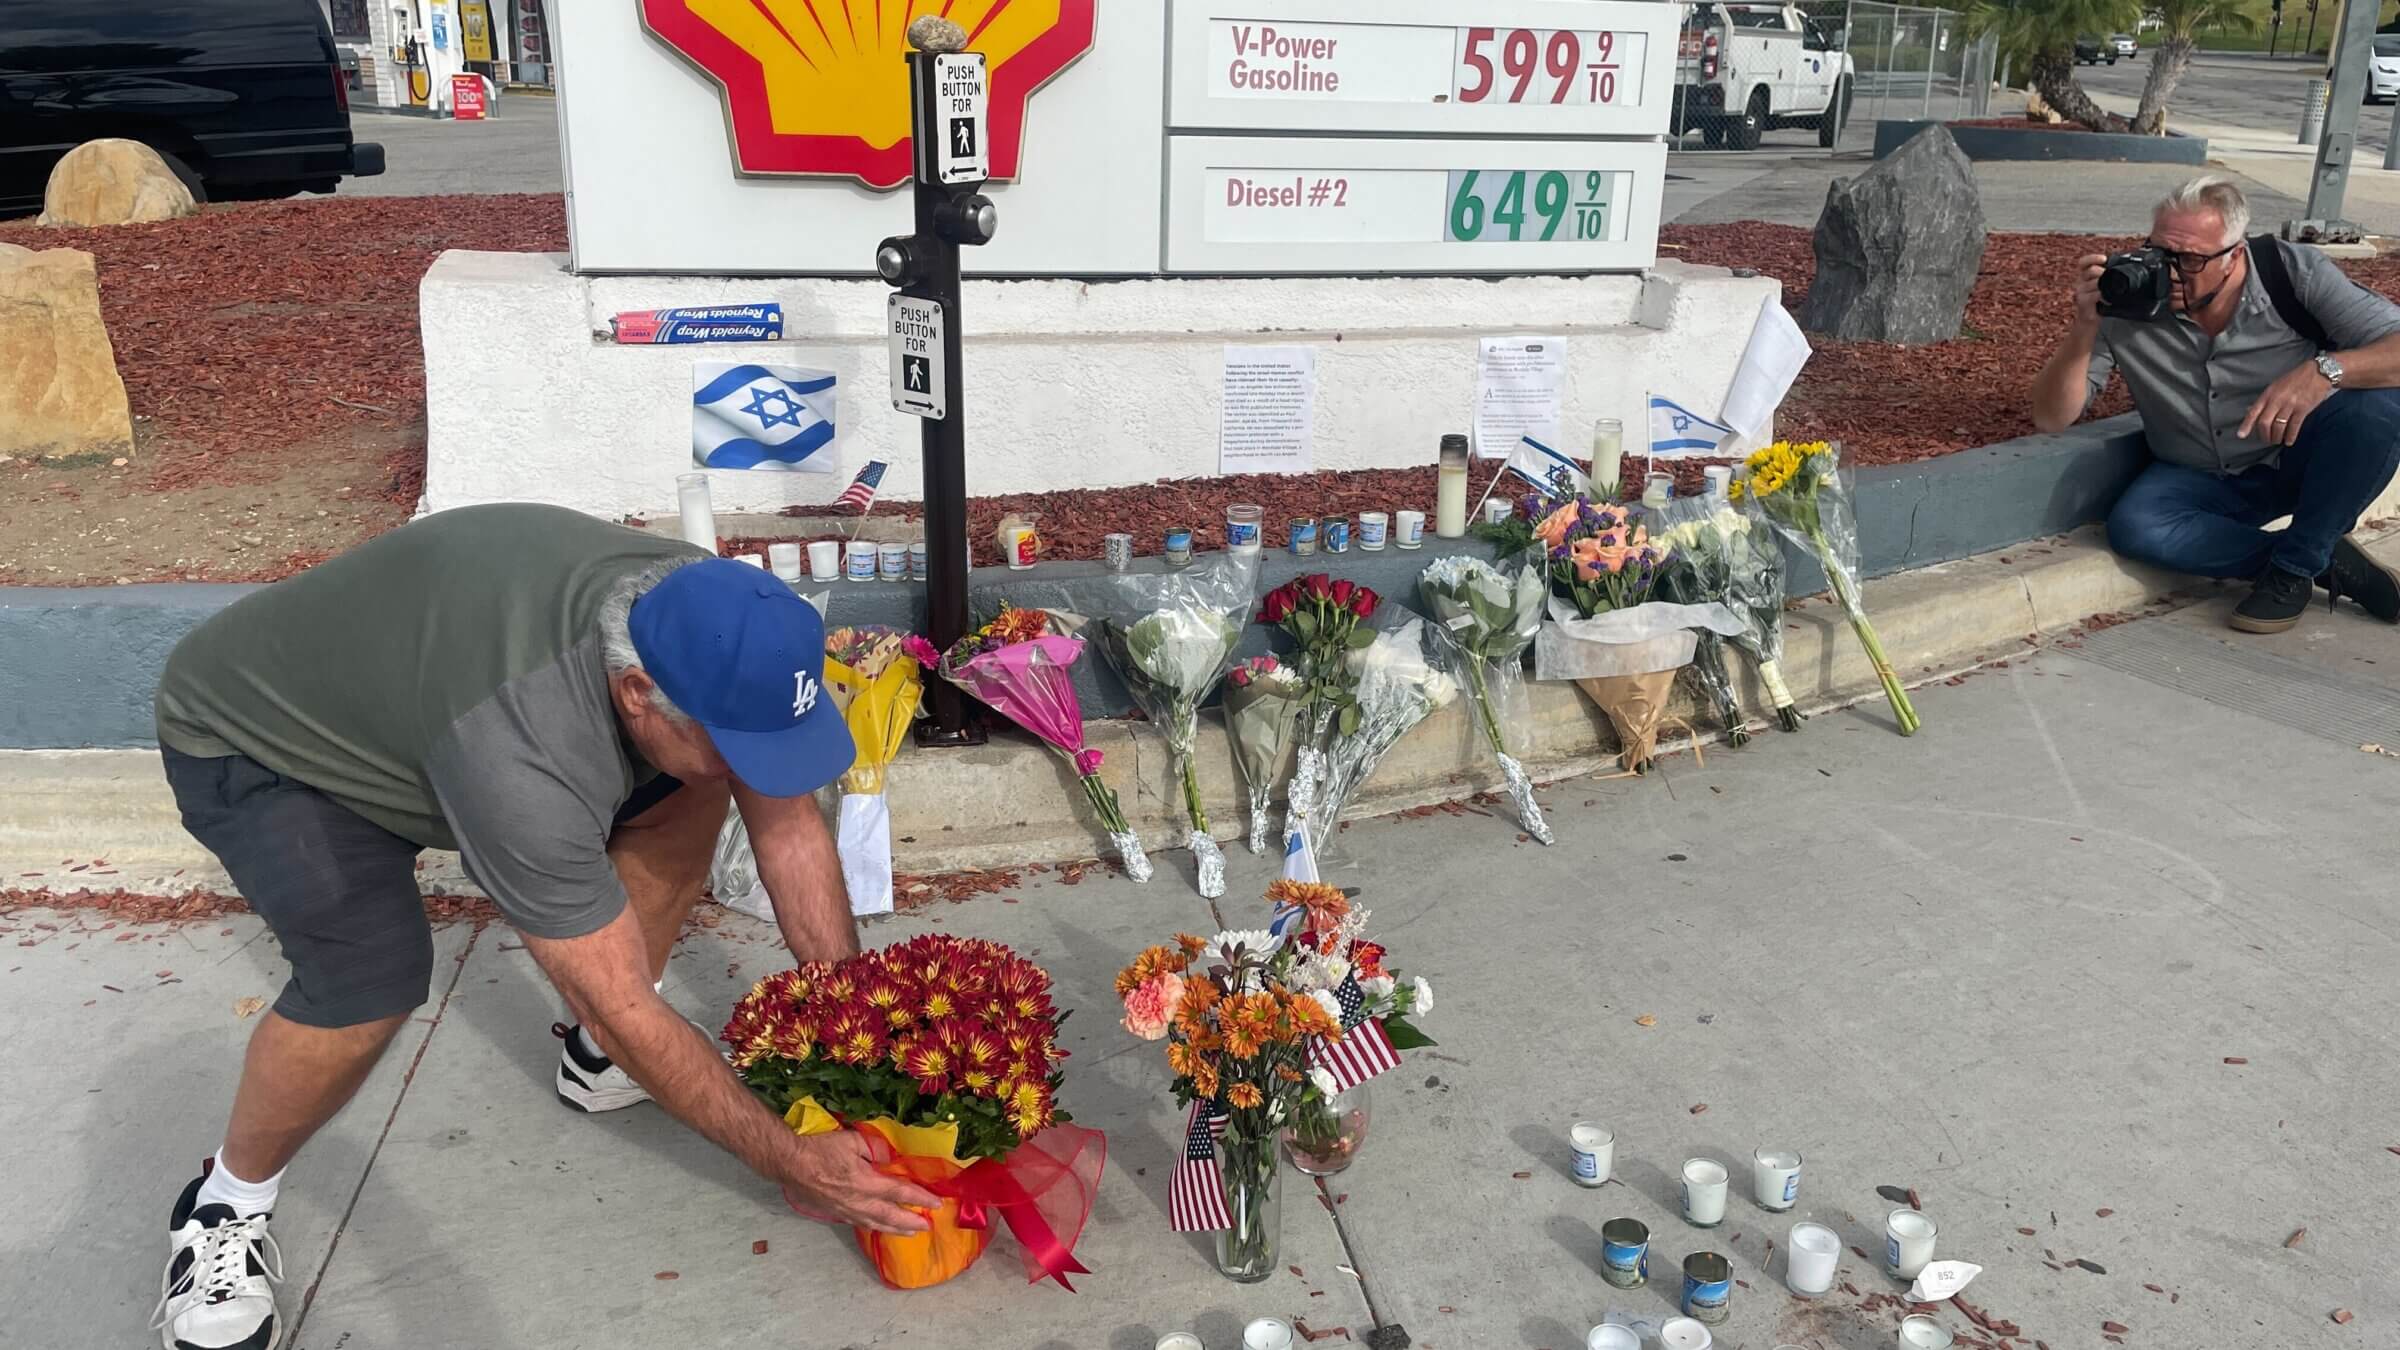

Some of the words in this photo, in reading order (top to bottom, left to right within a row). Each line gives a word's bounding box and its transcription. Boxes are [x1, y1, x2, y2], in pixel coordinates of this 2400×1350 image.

[1232, 26, 1337, 59] V-Power
[1599, 31, 1613, 62] 9
[947, 65, 975, 80] PUSH
[1229, 59, 1339, 92] Gasoline
[1459, 27, 1580, 104] 599
[942, 82, 981, 97] BUTTON
[1590, 71, 1614, 103] 10
[952, 98, 972, 113] FOR
[1227, 177, 1303, 207] Diesel
[1307, 178, 1348, 207] #2
[1586, 171, 1601, 200] 9
[1451, 170, 1569, 241] 649
[1577, 209, 1602, 239] 10
[676, 310, 708, 320] Wrap
[709, 308, 765, 319] Reynolds
[900, 306, 930, 323] PUSH
[677, 325, 709, 339] Wrap
[710, 323, 766, 337] Reynolds
[895, 320, 937, 340] BUTTON
[905, 337, 927, 353] FOR
[793, 670, 818, 717] LA
